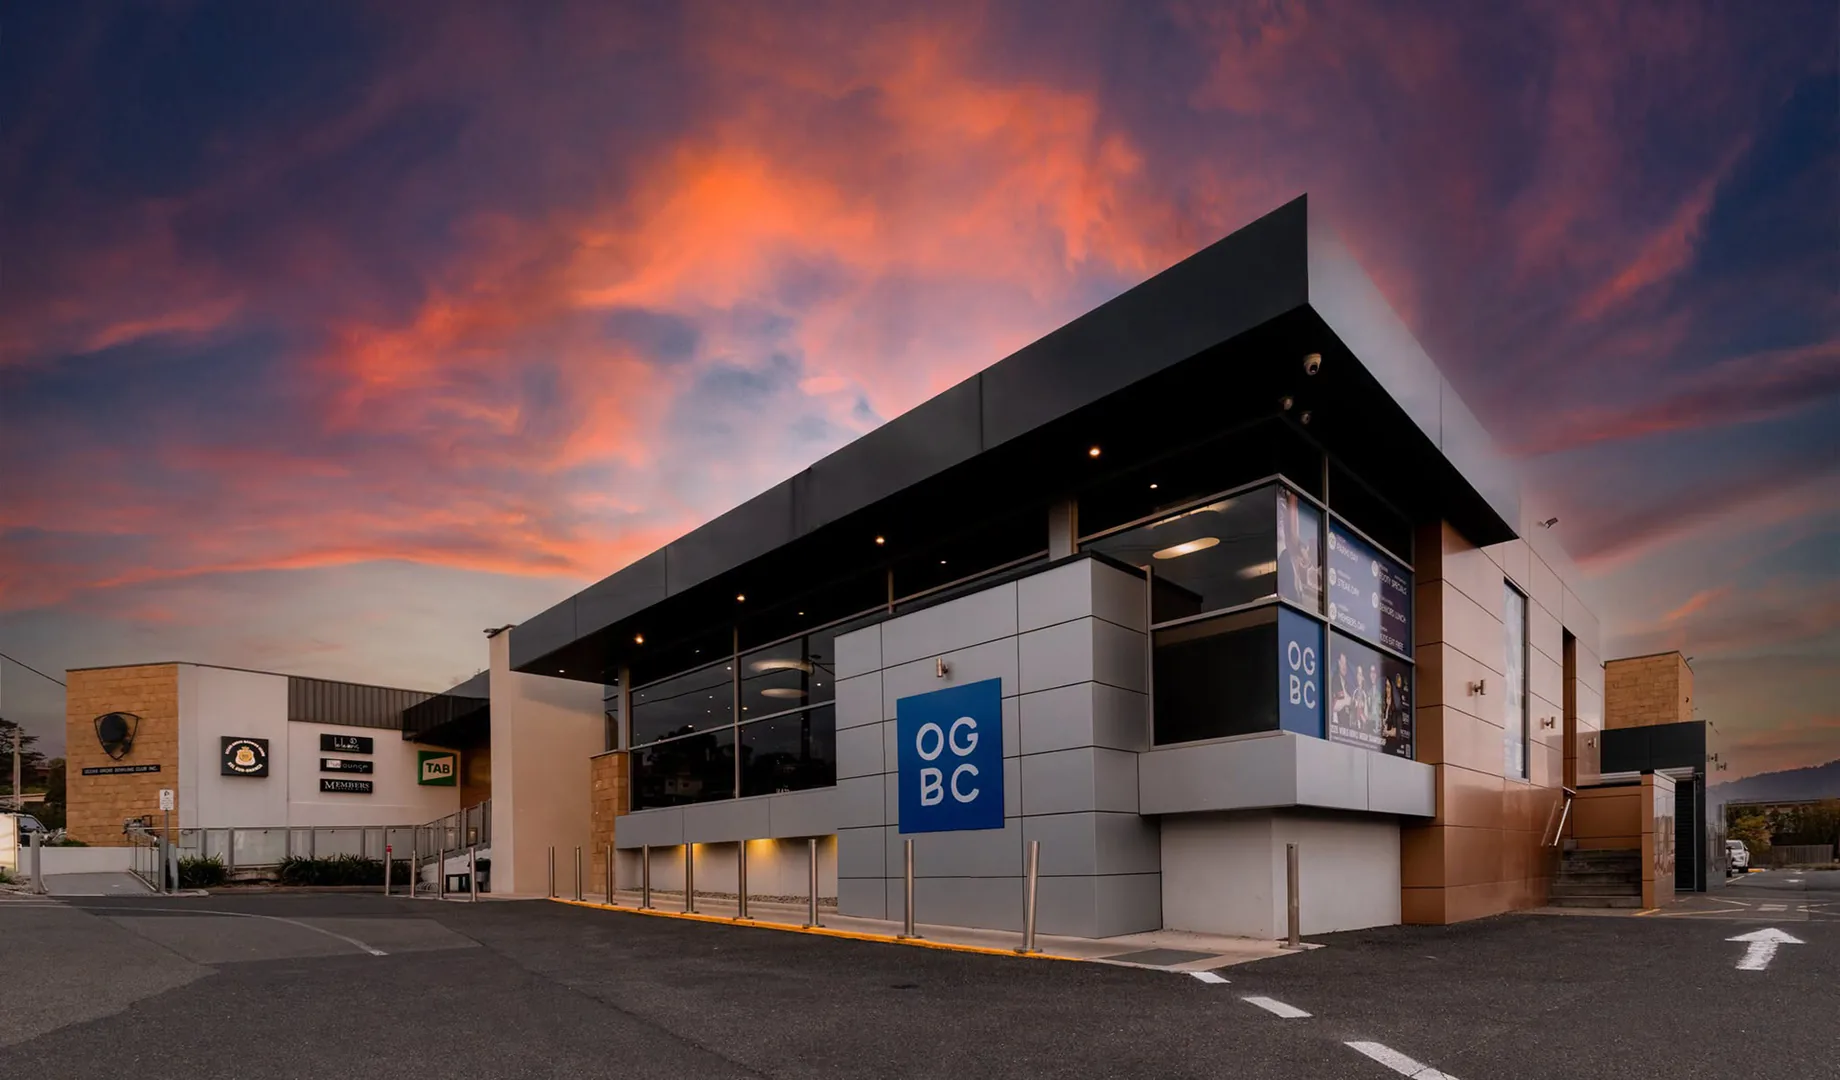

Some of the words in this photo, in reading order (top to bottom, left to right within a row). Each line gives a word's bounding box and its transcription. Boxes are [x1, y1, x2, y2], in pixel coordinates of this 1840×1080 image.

[1287, 640, 1315, 676] OG
[1289, 673, 1316, 709] BC
[915, 716, 979, 761] OG
[325, 780, 370, 790] MEMBERS
[426, 762, 450, 774] TAB
[920, 763, 979, 806] BC
